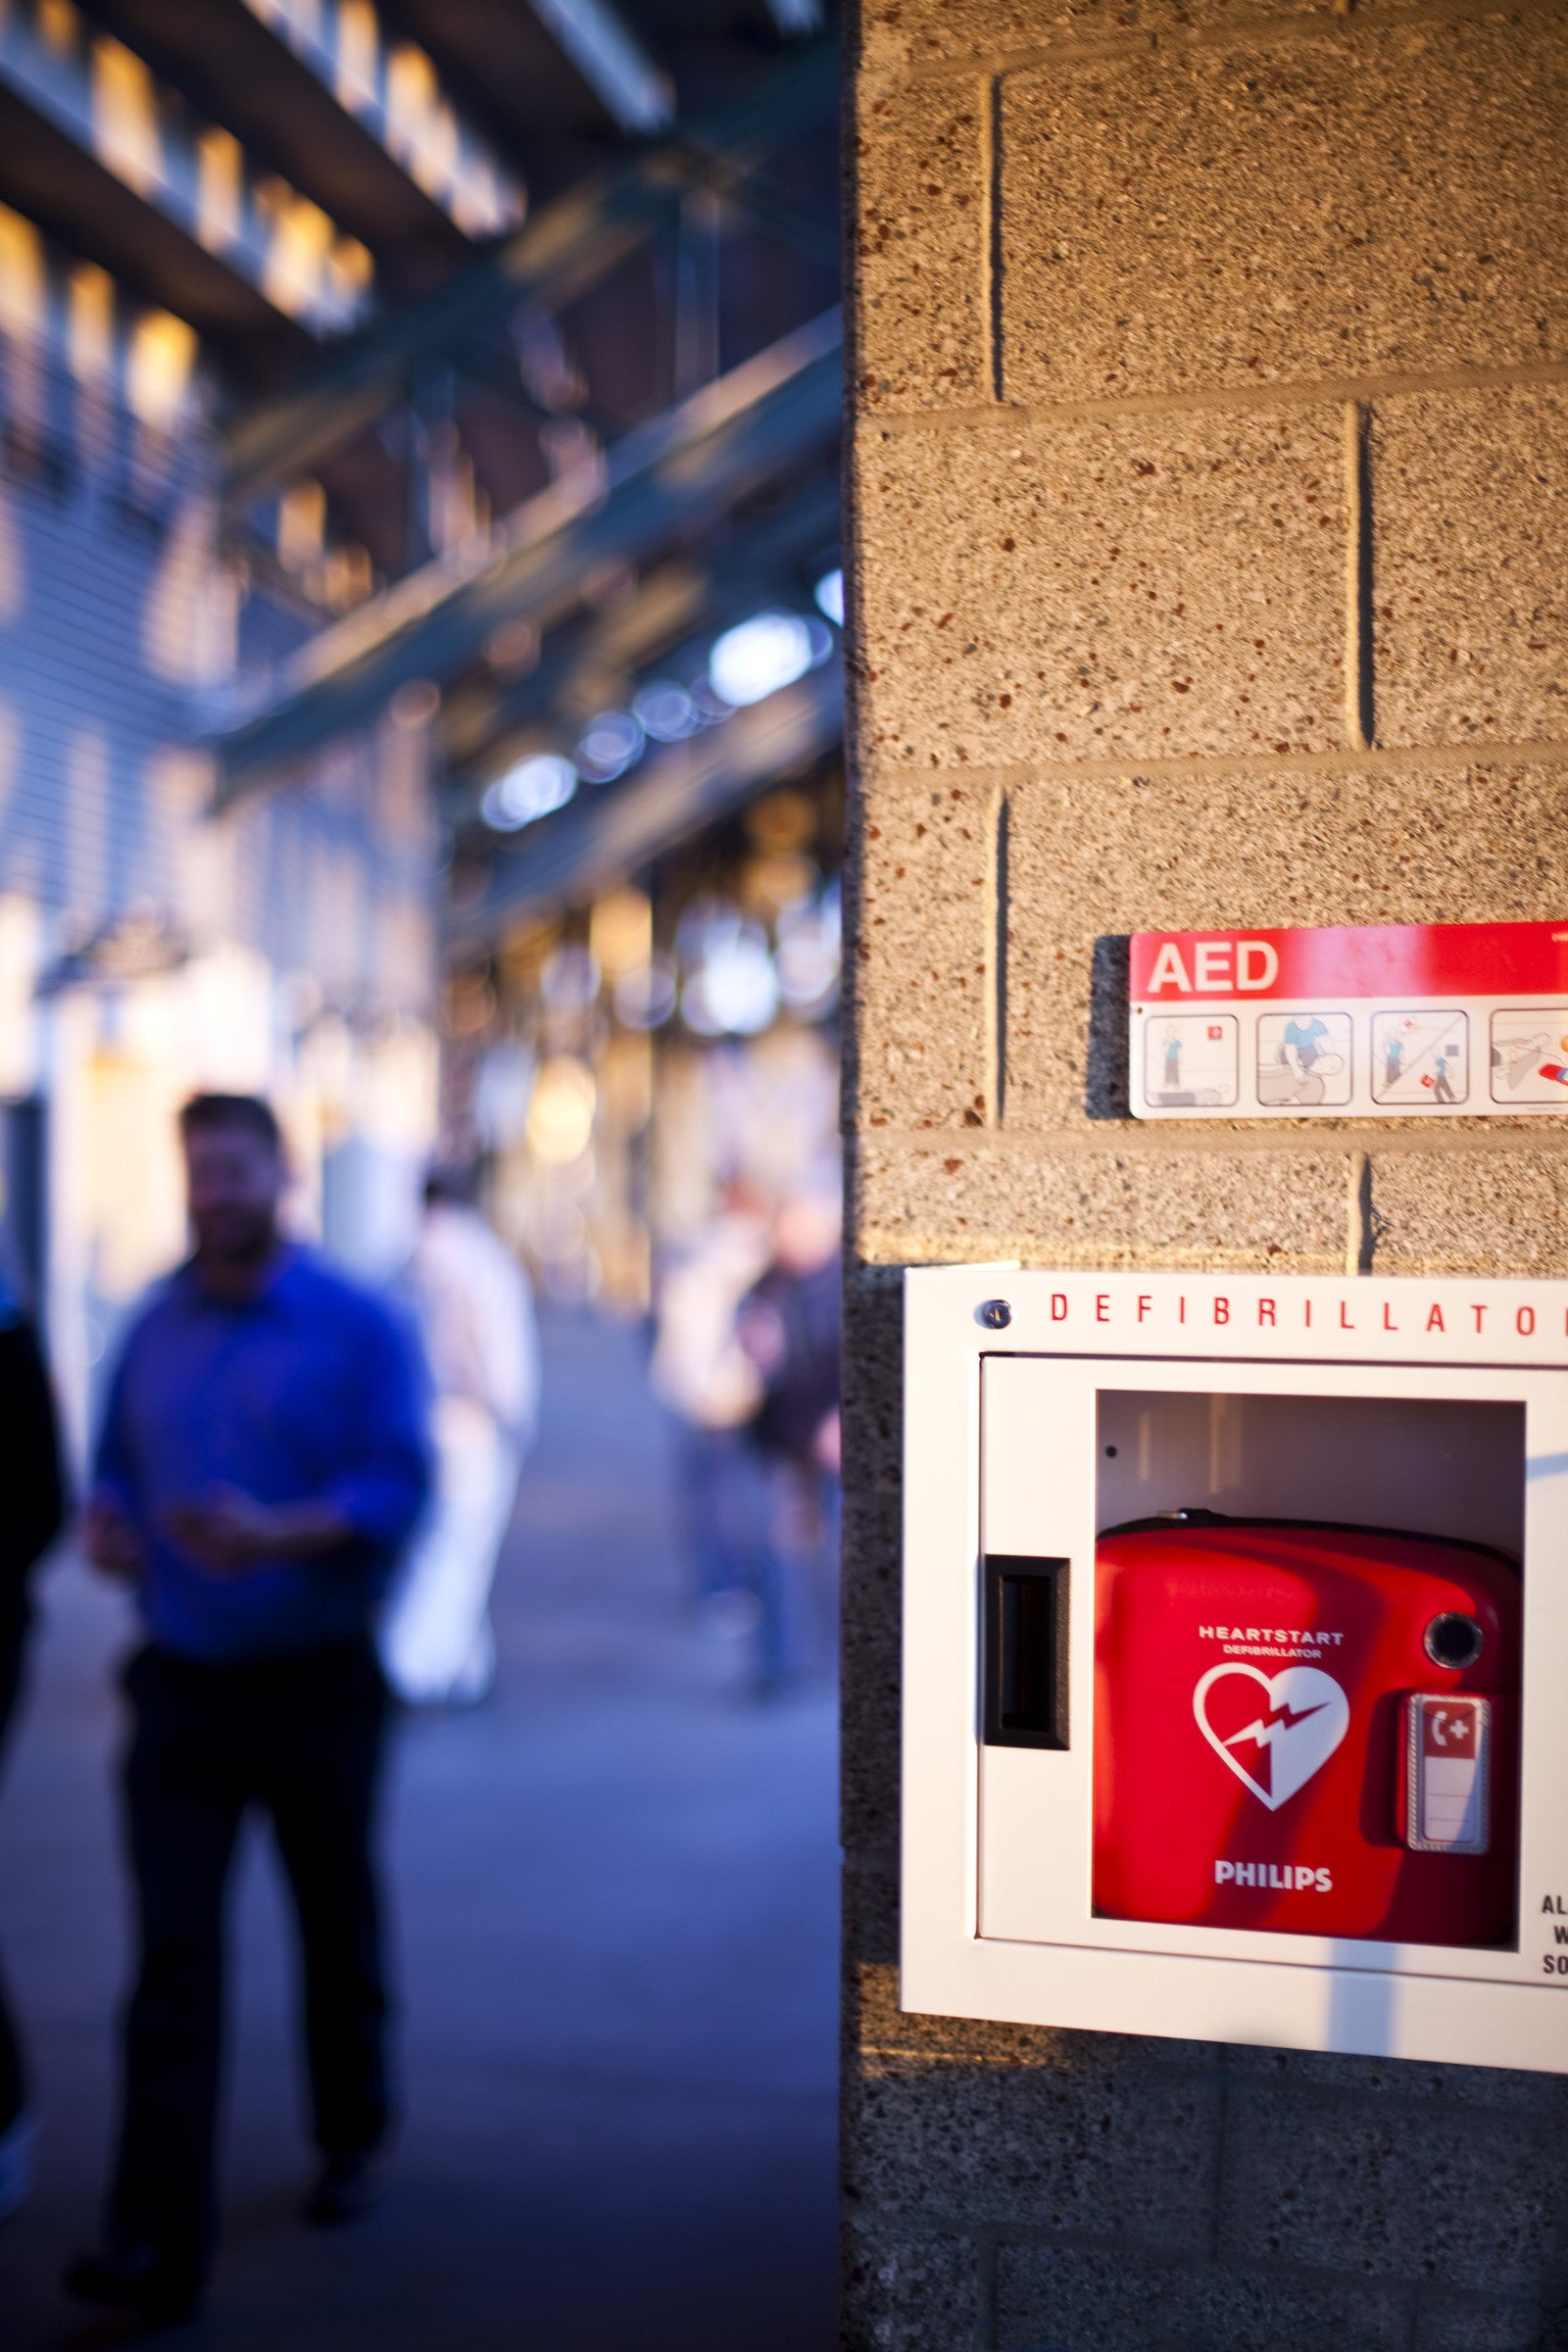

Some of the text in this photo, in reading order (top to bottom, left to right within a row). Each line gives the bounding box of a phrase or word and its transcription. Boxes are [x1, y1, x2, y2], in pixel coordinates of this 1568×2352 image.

[1147, 941, 1279, 993] AED
[1051, 1293, 1568, 1337] DEFIBRILLATO
[1199, 1625, 1344, 1645] HEARTSTART
[1223, 1643, 1322, 1658] DEFIBRILLATOR
[1214, 1859, 1333, 1892] PHILIPS
